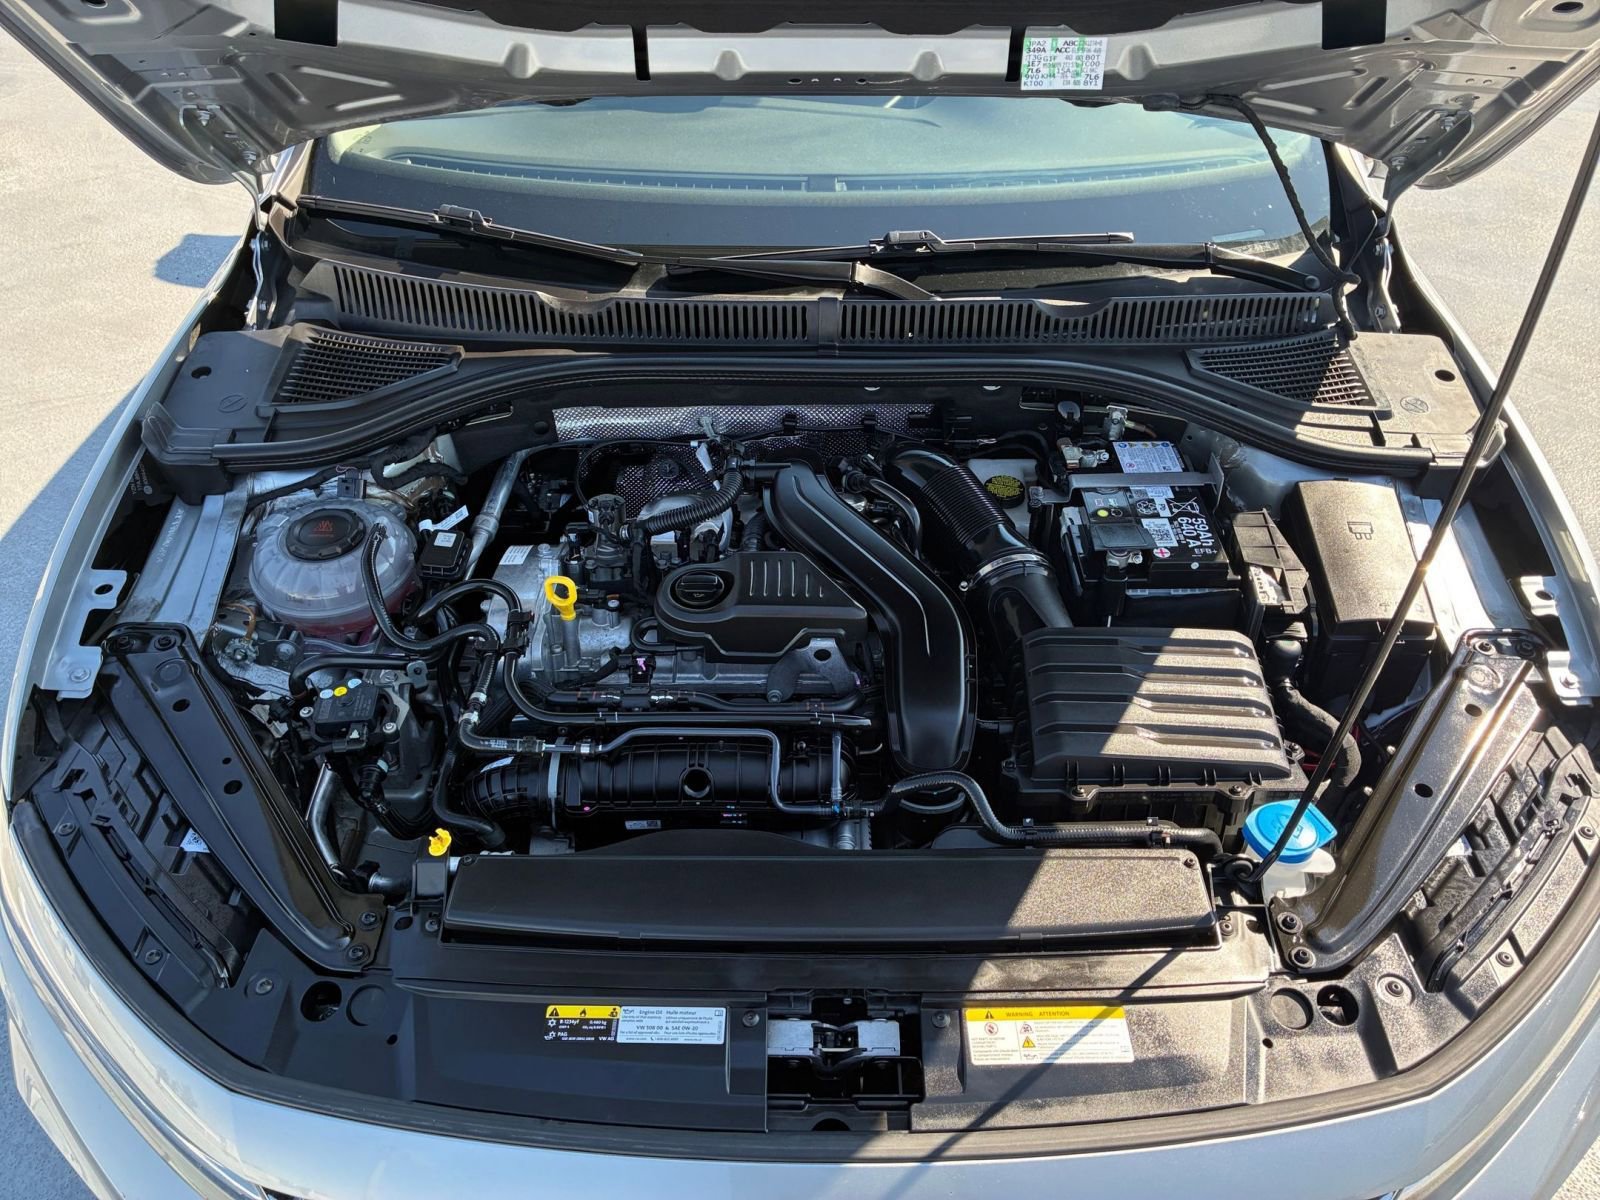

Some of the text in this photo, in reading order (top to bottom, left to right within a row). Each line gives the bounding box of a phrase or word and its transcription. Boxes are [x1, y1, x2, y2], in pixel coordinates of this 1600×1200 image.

[1178, 517, 1197, 537] 640
[1191, 516, 1215, 547] 59Ah
[1186, 538, 1200, 548] A
